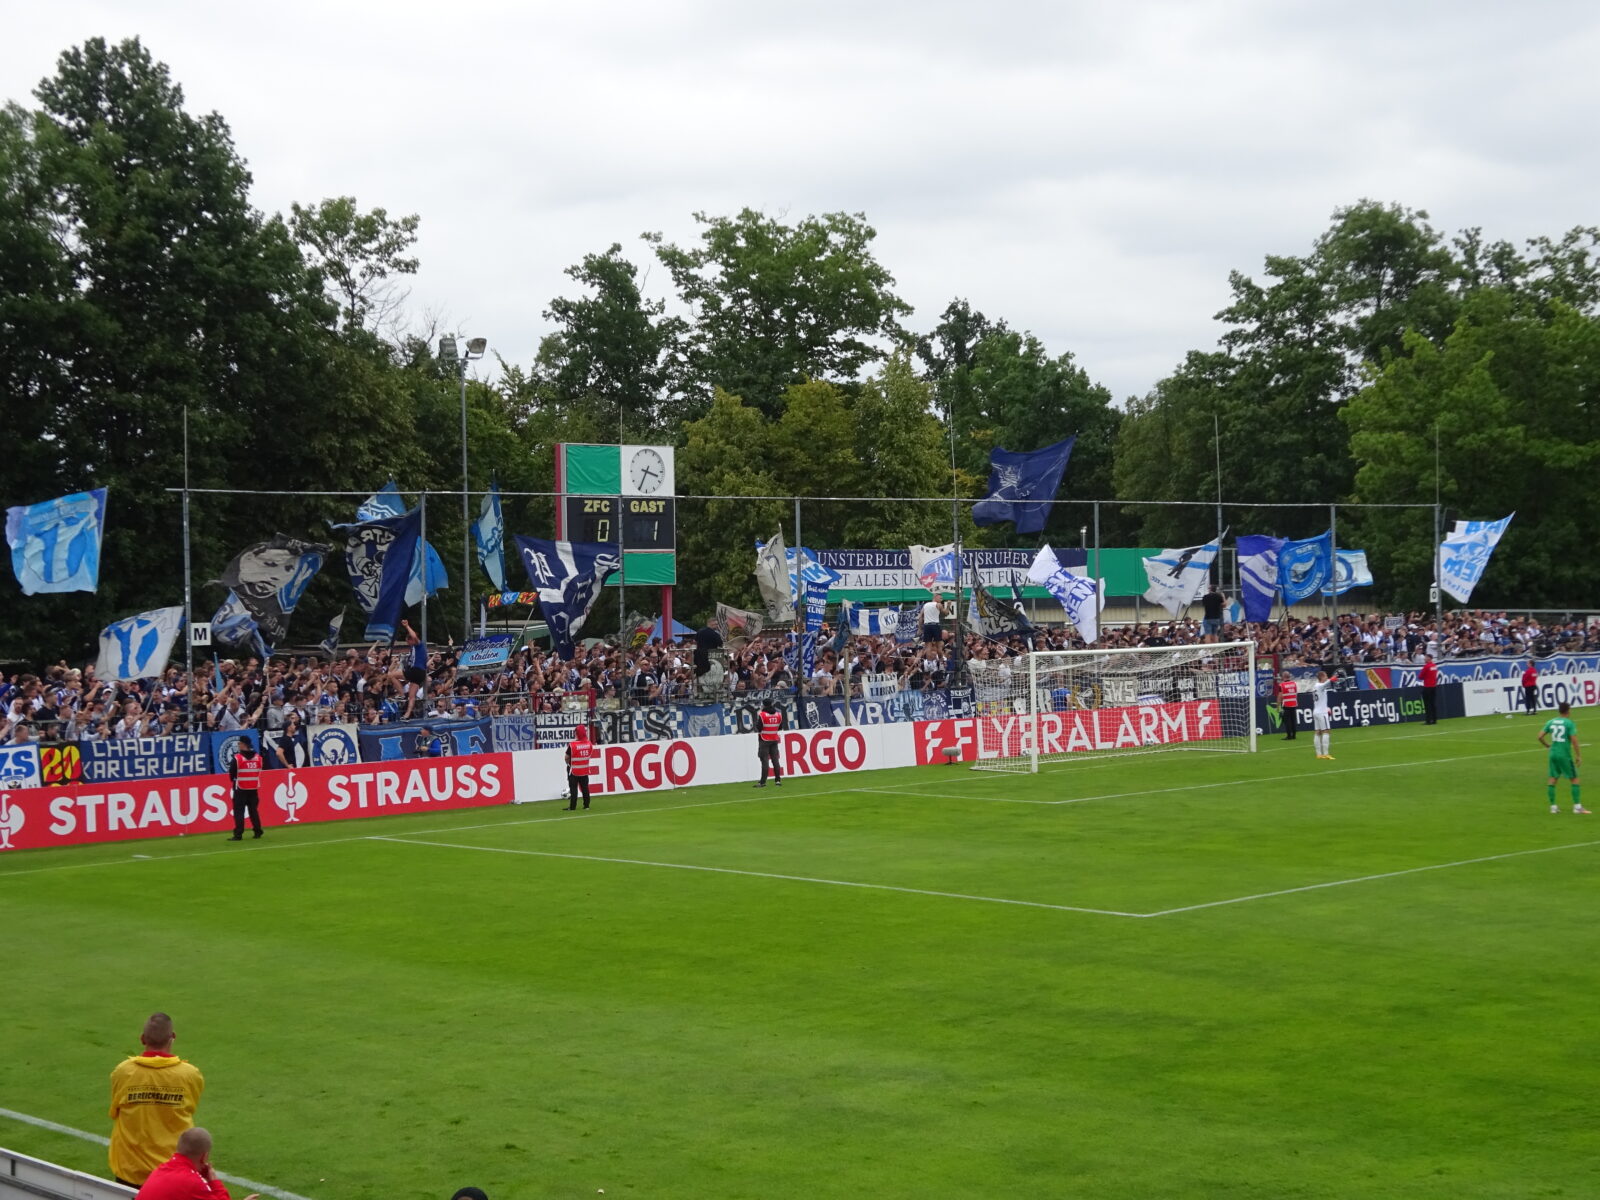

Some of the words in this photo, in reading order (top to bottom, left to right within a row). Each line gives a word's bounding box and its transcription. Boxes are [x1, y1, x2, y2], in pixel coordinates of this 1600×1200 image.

[583, 500, 611, 513] ZFC
[630, 500, 666, 513] GAST
[597, 519, 610, 542] 0
[653, 520, 659, 541] 1
[816, 551, 913, 567] UNSTERBLIC
[854, 573, 899, 587] ALLES
[903, 573, 923, 587] UN
[193, 627, 208, 641] M
[1583, 680, 1600, 704] B
[536, 712, 588, 726] WESTSIDE
[1354, 697, 1399, 723] fertig,
[1399, 696, 1425, 716] los!
[495, 724, 535, 741] UNS
[536, 729, 577, 741] KARLSRU
[953, 703, 1189, 760] FLYERALARM
[1549, 725, 1566, 743] 22
[91, 734, 202, 758] CHAOTEN
[768, 728, 866, 777] RGO
[82, 754, 207, 780] KARLSRUHE
[578, 740, 697, 794] ERGO
[327, 763, 501, 811] STRAUSS
[48, 784, 250, 836] STRAUS
